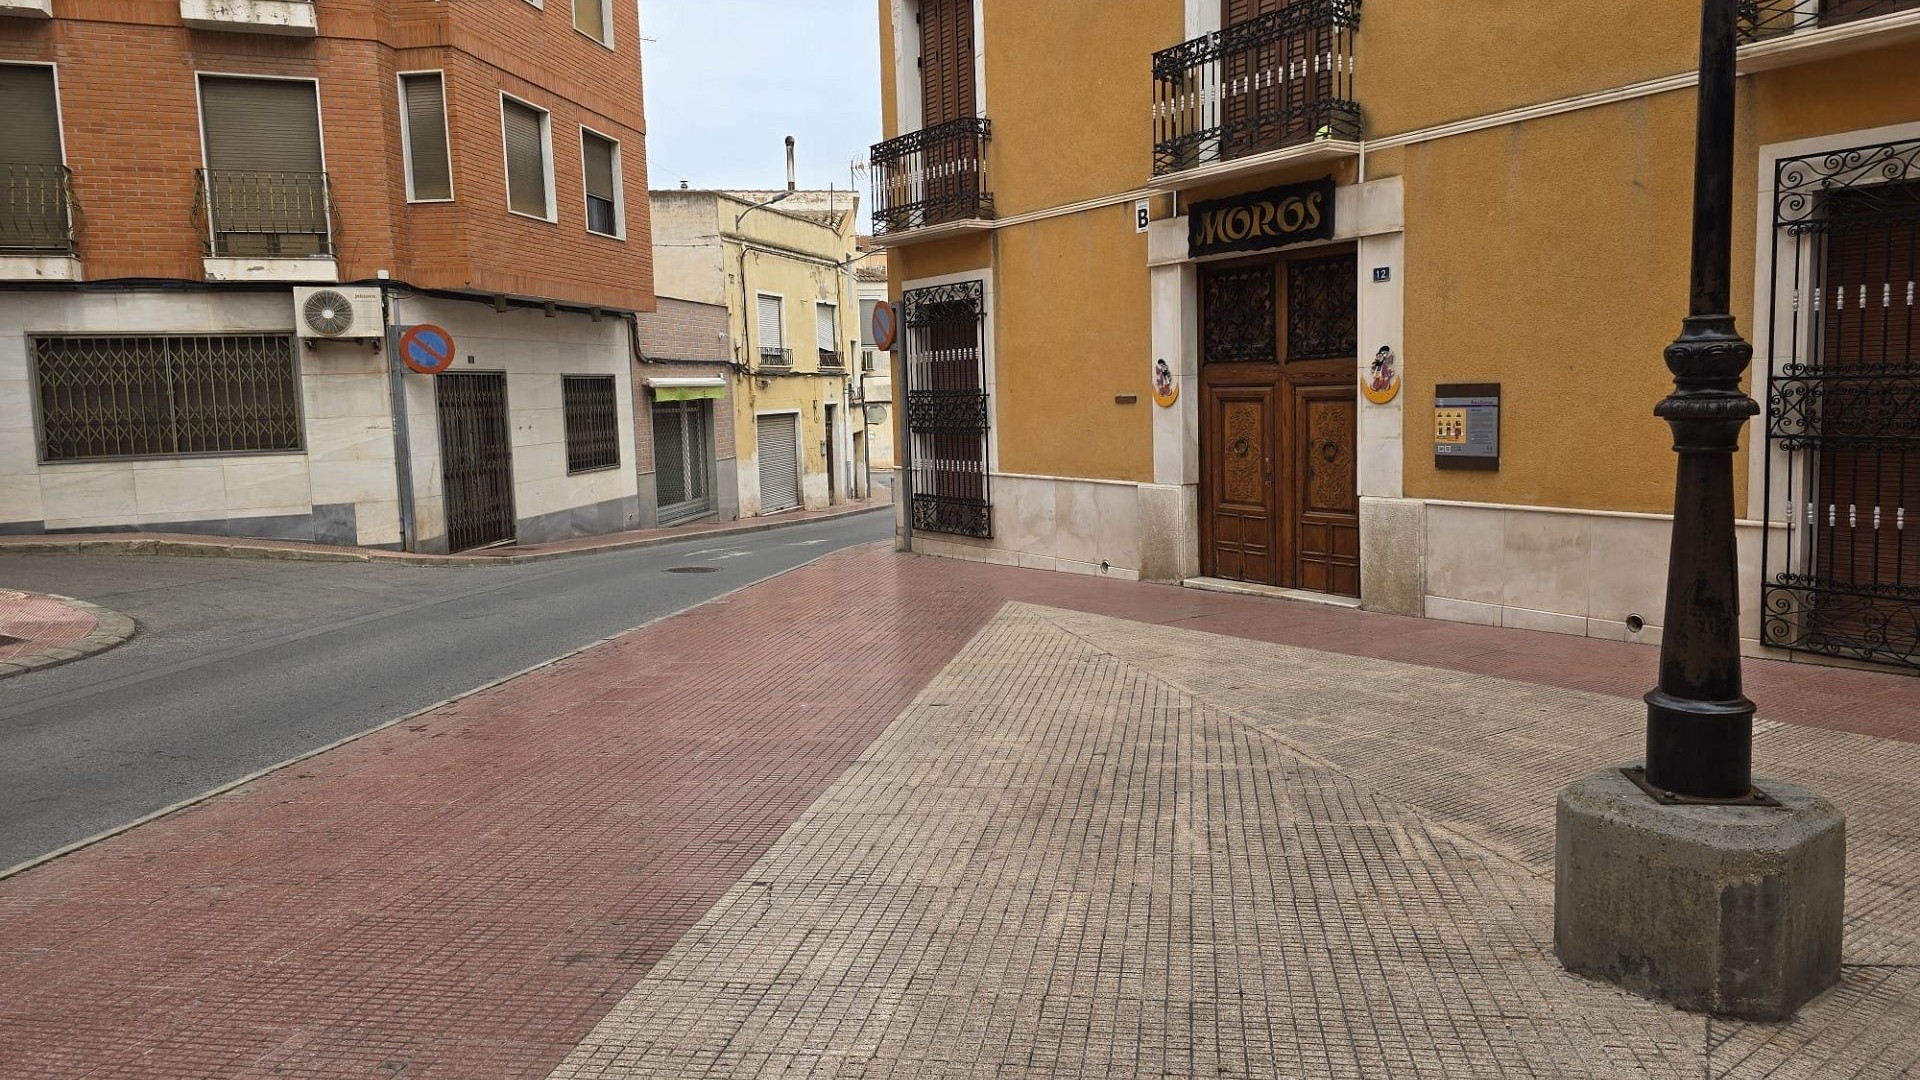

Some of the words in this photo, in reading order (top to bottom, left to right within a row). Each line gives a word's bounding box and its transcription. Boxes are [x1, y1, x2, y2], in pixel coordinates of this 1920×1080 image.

[1138, 209, 1148, 228] B
[1198, 191, 1322, 245] MOROS
[1376, 269, 1386, 279] 12
